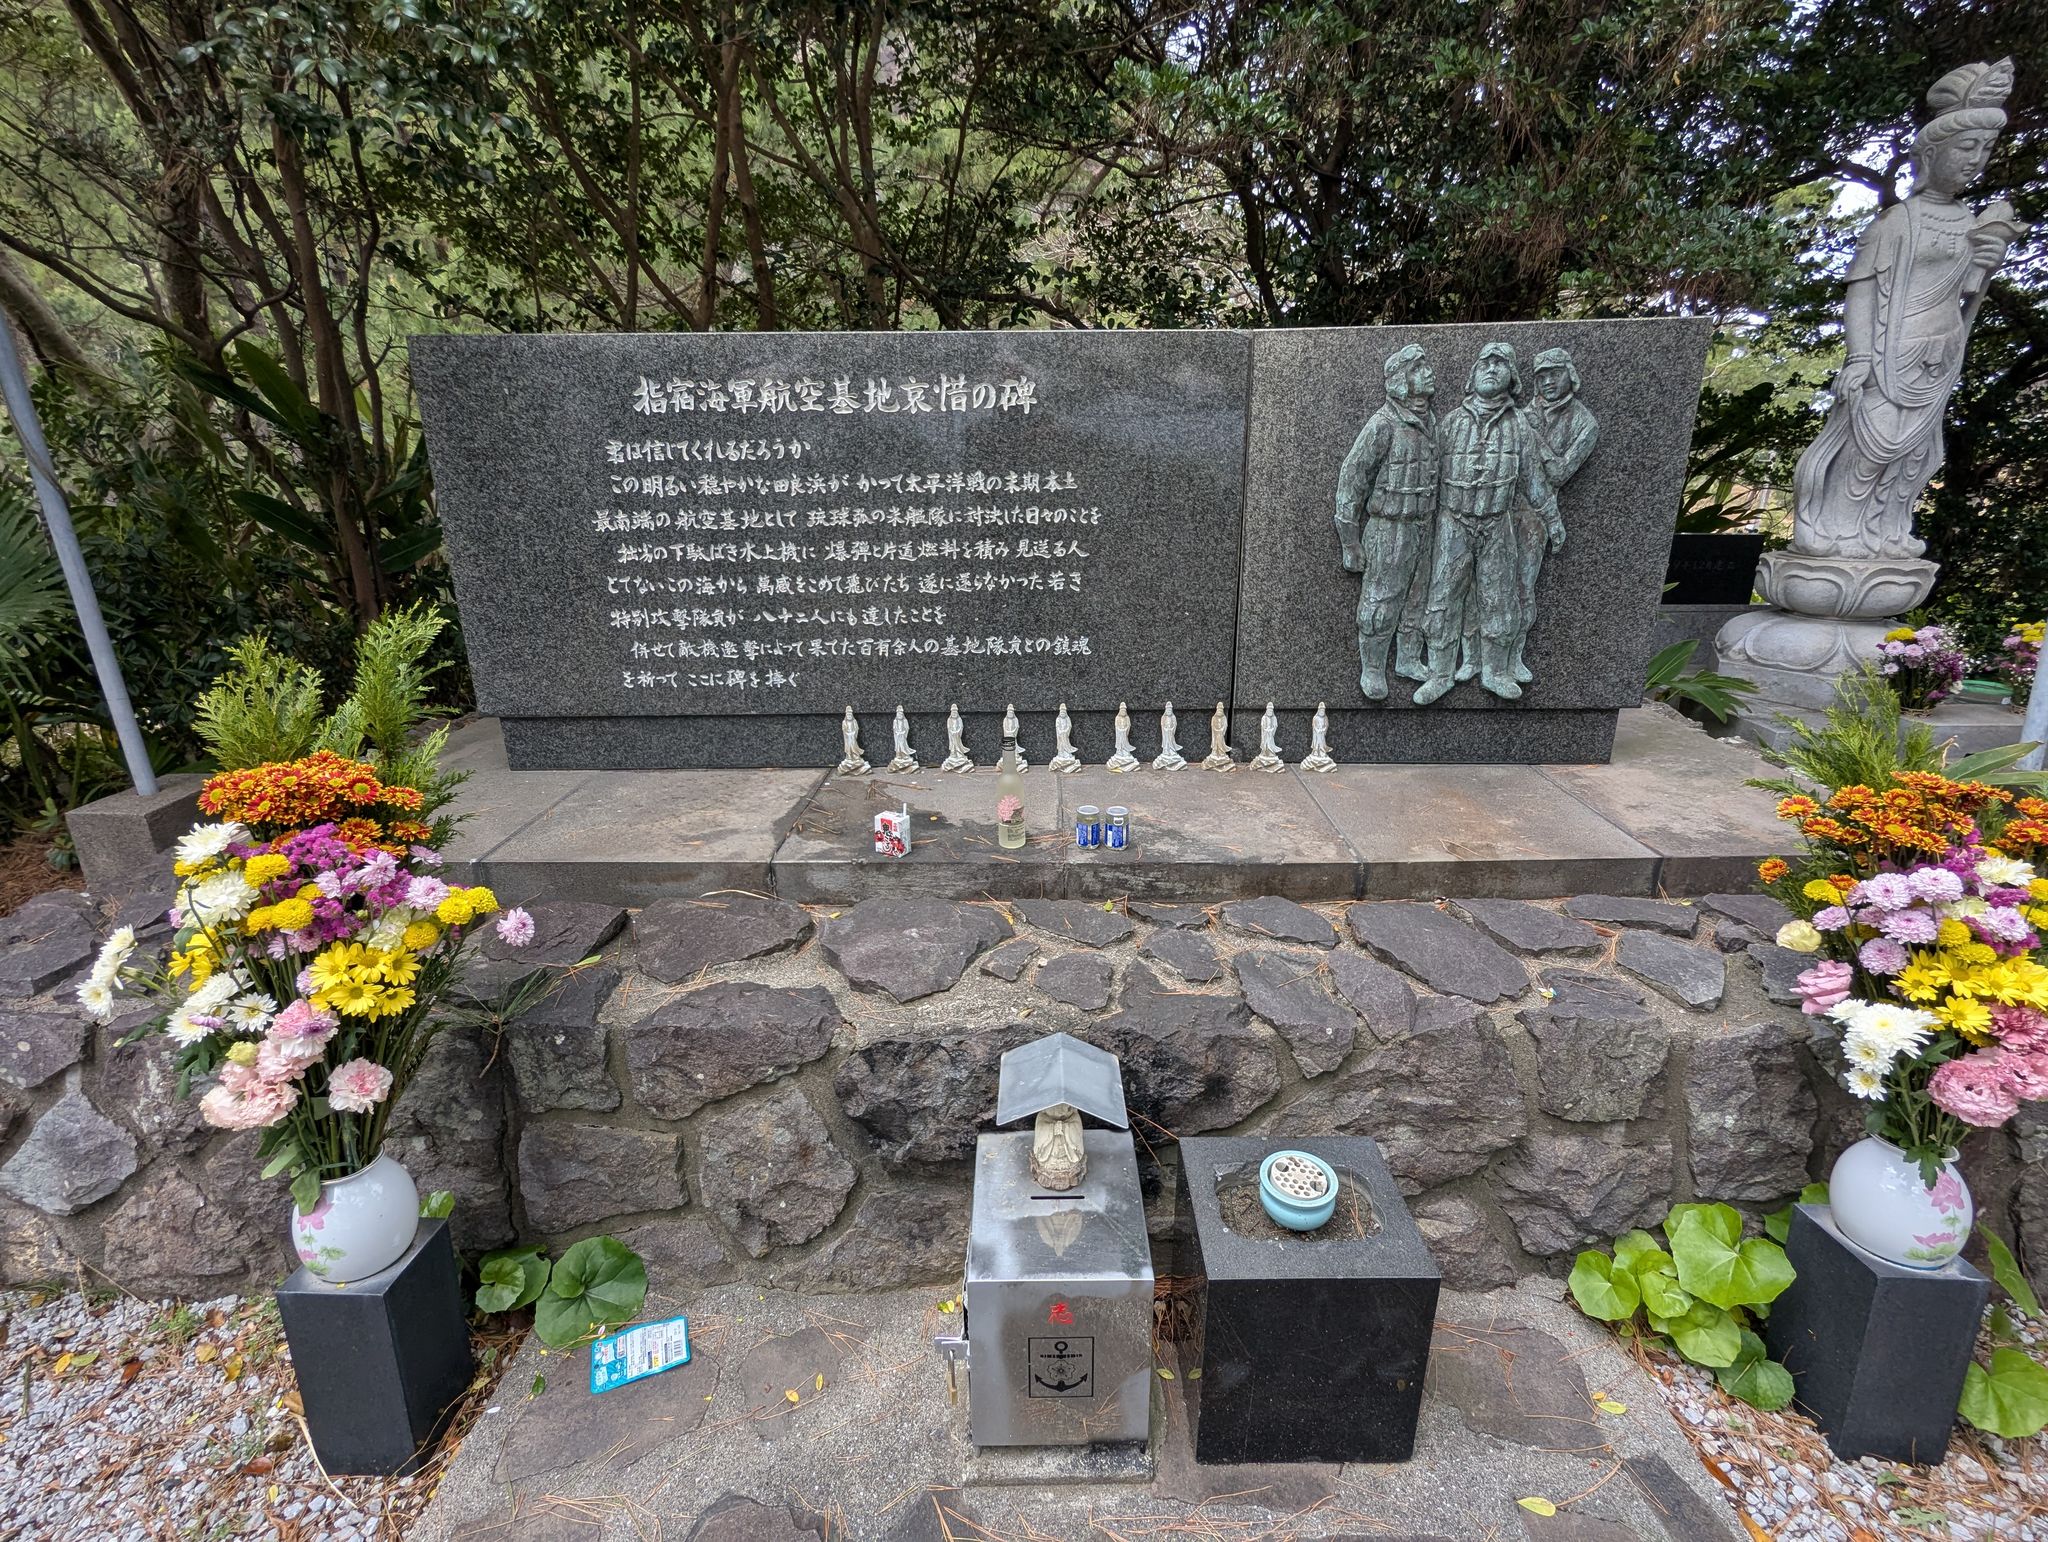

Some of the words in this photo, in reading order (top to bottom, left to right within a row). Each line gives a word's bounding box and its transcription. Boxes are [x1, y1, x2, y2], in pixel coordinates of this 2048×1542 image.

[604, 437, 812, 463] 君は信じてくれるだろうか
